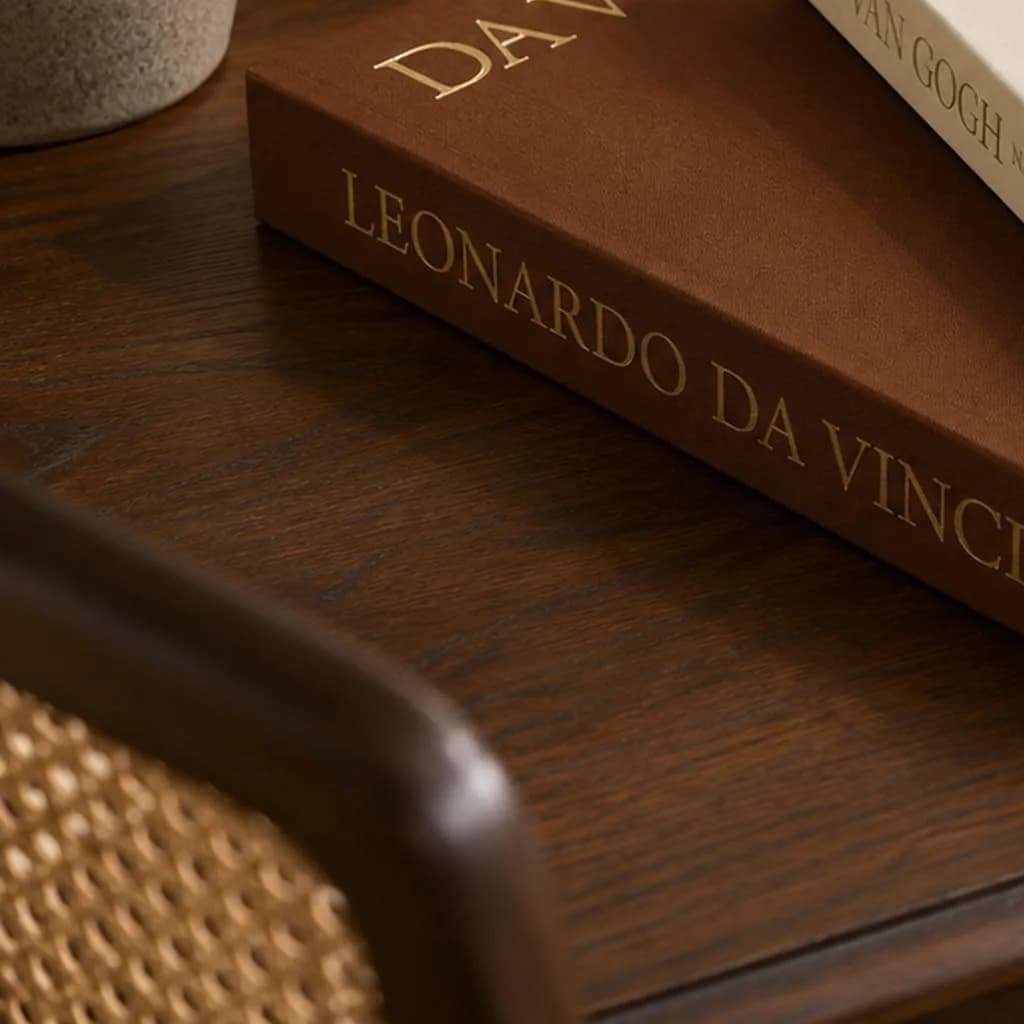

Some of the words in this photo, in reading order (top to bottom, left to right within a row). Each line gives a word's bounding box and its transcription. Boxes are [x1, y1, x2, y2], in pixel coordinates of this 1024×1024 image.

[374, 19, 577, 100] DA
[912, 35, 1004, 166] GOGH
[341, 168, 687, 397] LEONARDO
[711, 361, 805, 467] DA
